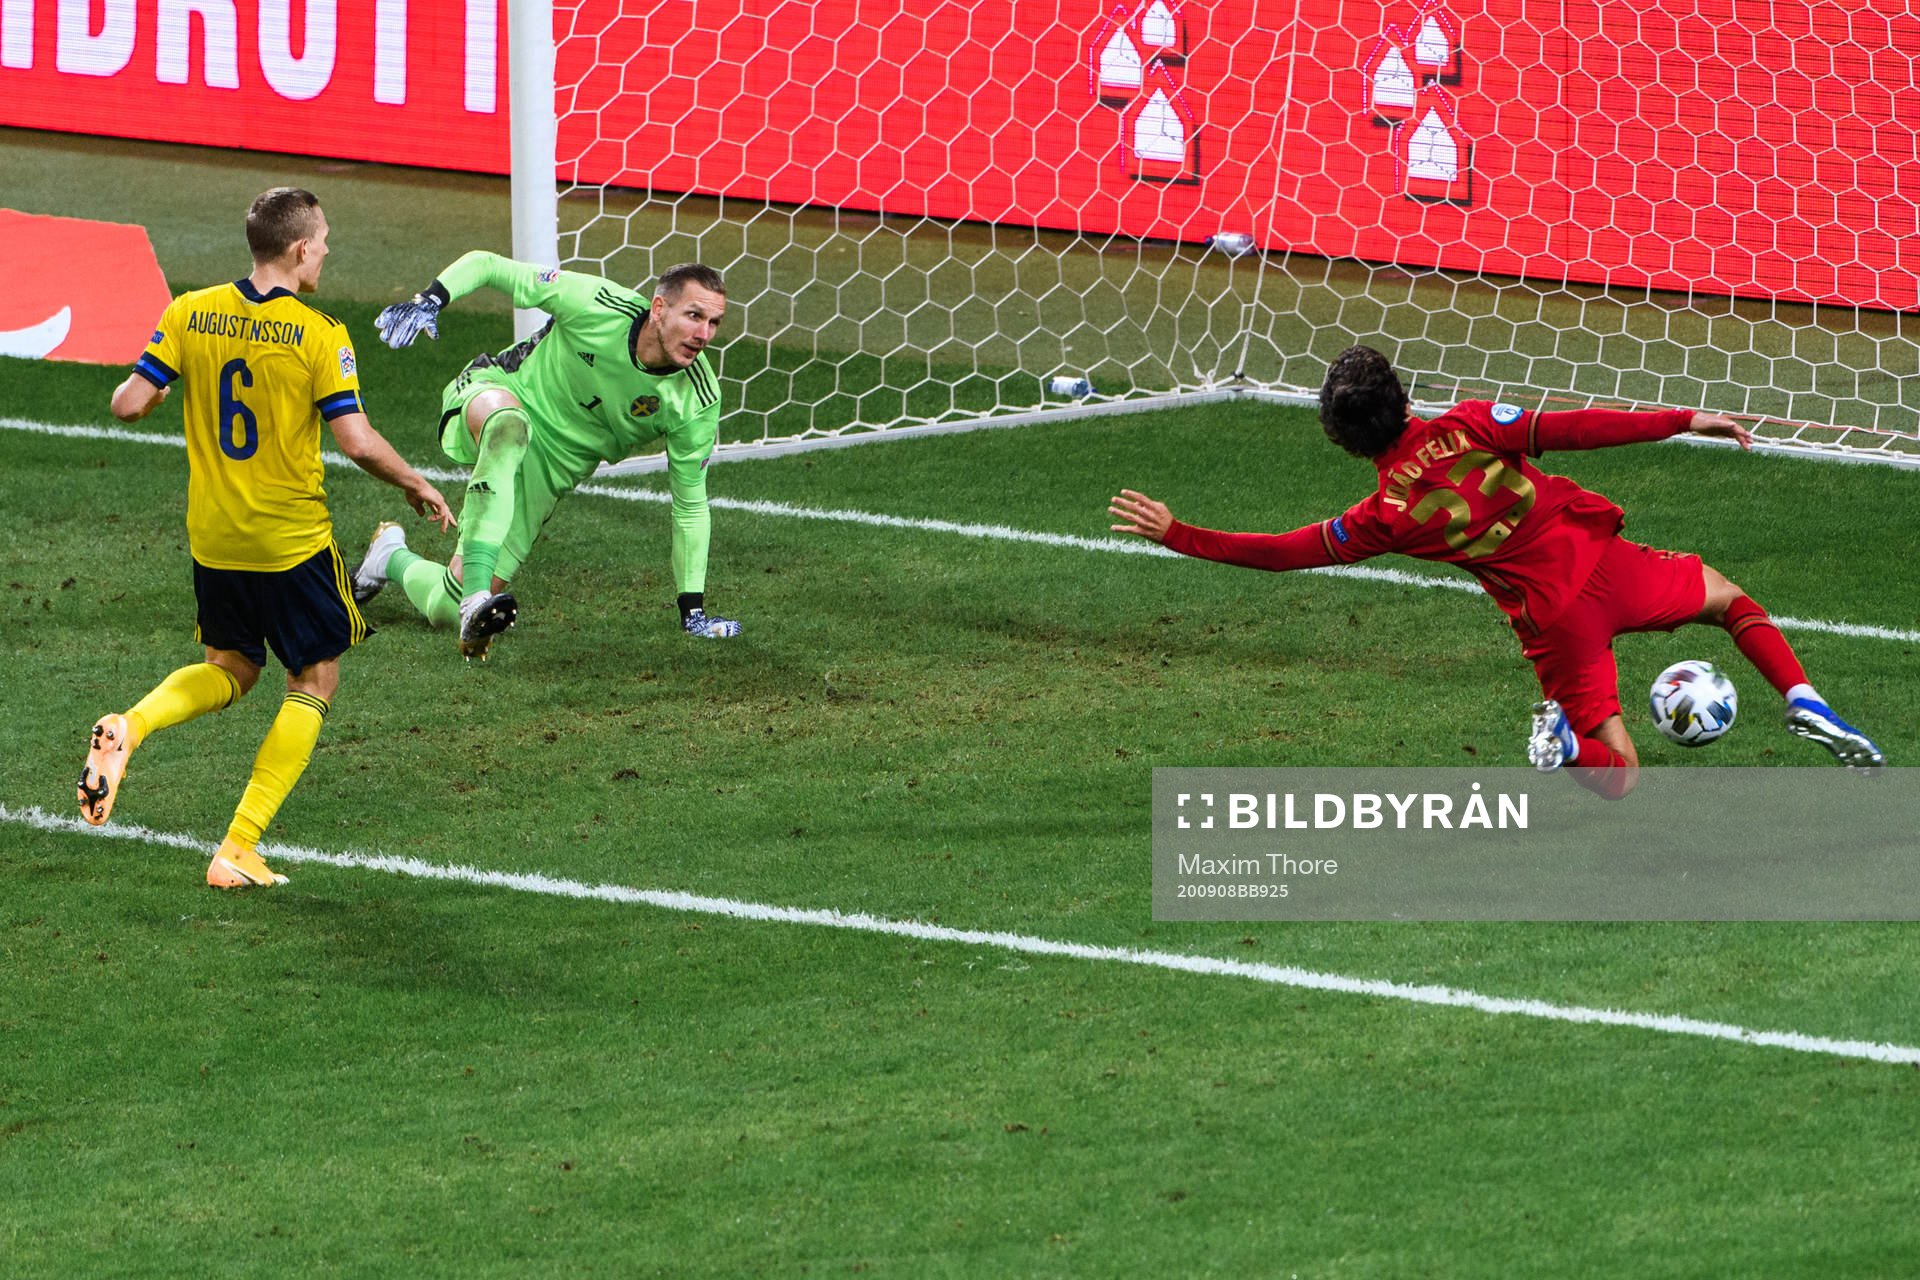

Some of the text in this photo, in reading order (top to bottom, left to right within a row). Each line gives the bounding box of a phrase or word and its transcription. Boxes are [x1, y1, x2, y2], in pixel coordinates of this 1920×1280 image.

[187, 310, 305, 347] AUGUSTNSSON
[218, 357, 259, 461] 6
[579, 395, 603, 411] 1
[1383, 461, 1423, 512] JOÃO
[1409, 450, 1536, 559] 23
